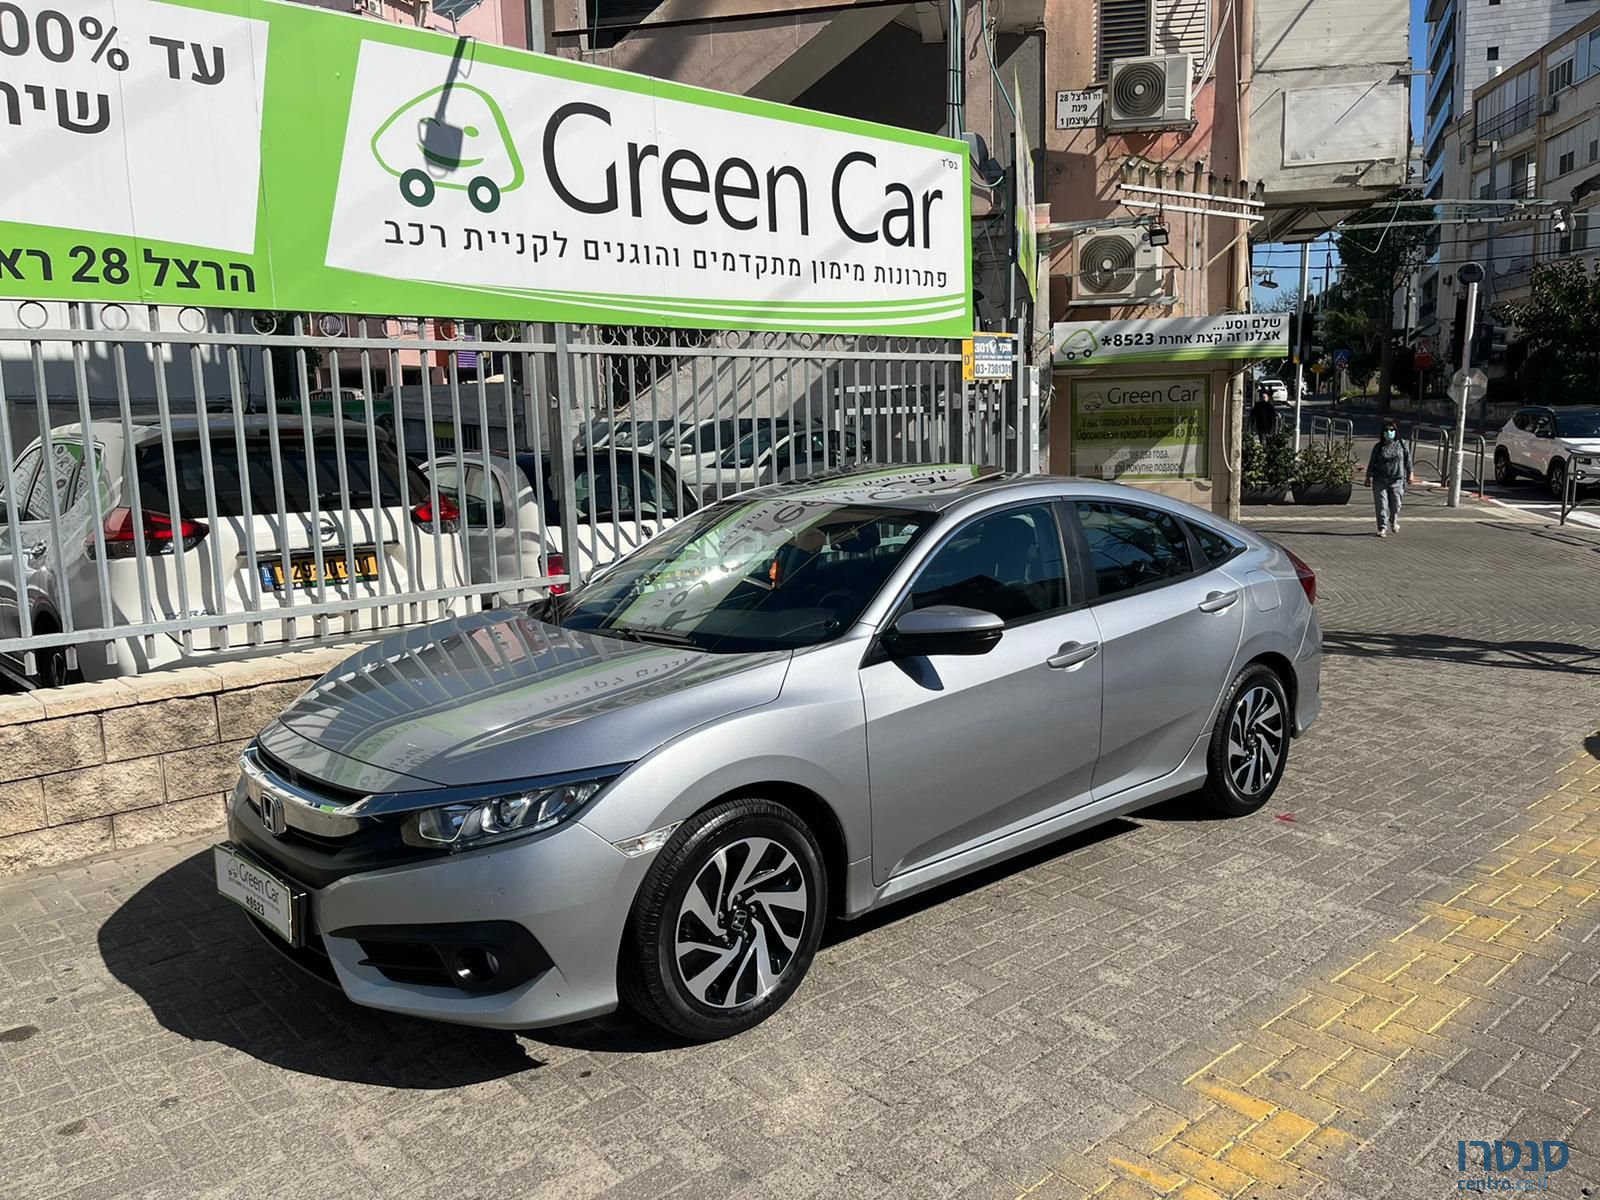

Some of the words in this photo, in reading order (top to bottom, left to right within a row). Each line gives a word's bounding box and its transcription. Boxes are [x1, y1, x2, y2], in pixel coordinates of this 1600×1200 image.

[150, 36, 224, 85] עד
[1060, 94, 1069, 102] 28
[1071, 92, 1091, 101] הרצל
[1072, 104, 1088, 112] פינת
[542, 102, 810, 237] Green
[831, 151, 943, 249] Car
[384, 220, 447, 248] רכב
[463, 229, 568, 262] לקניית
[584, 240, 680, 267] והוגנים
[69, 245, 130, 285] 28
[143, 248, 256, 293] הרצל
[693, 249, 801, 280] מתקדמים
[811, 260, 865, 284] מימון
[875, 267, 947, 288] פתרונות
[1252, 317, 1281, 328] שלם
[1158, 333, 1192, 345] אחרת
[1196, 331, 1222, 345] קצת
[1226, 331, 1241, 342] זה
[1244, 330, 1281, 341] אצלנו
[1107, 387, 1162, 405] Green
[1167, 385, 1199, 403] Car
[240, 863, 264, 895] Green
